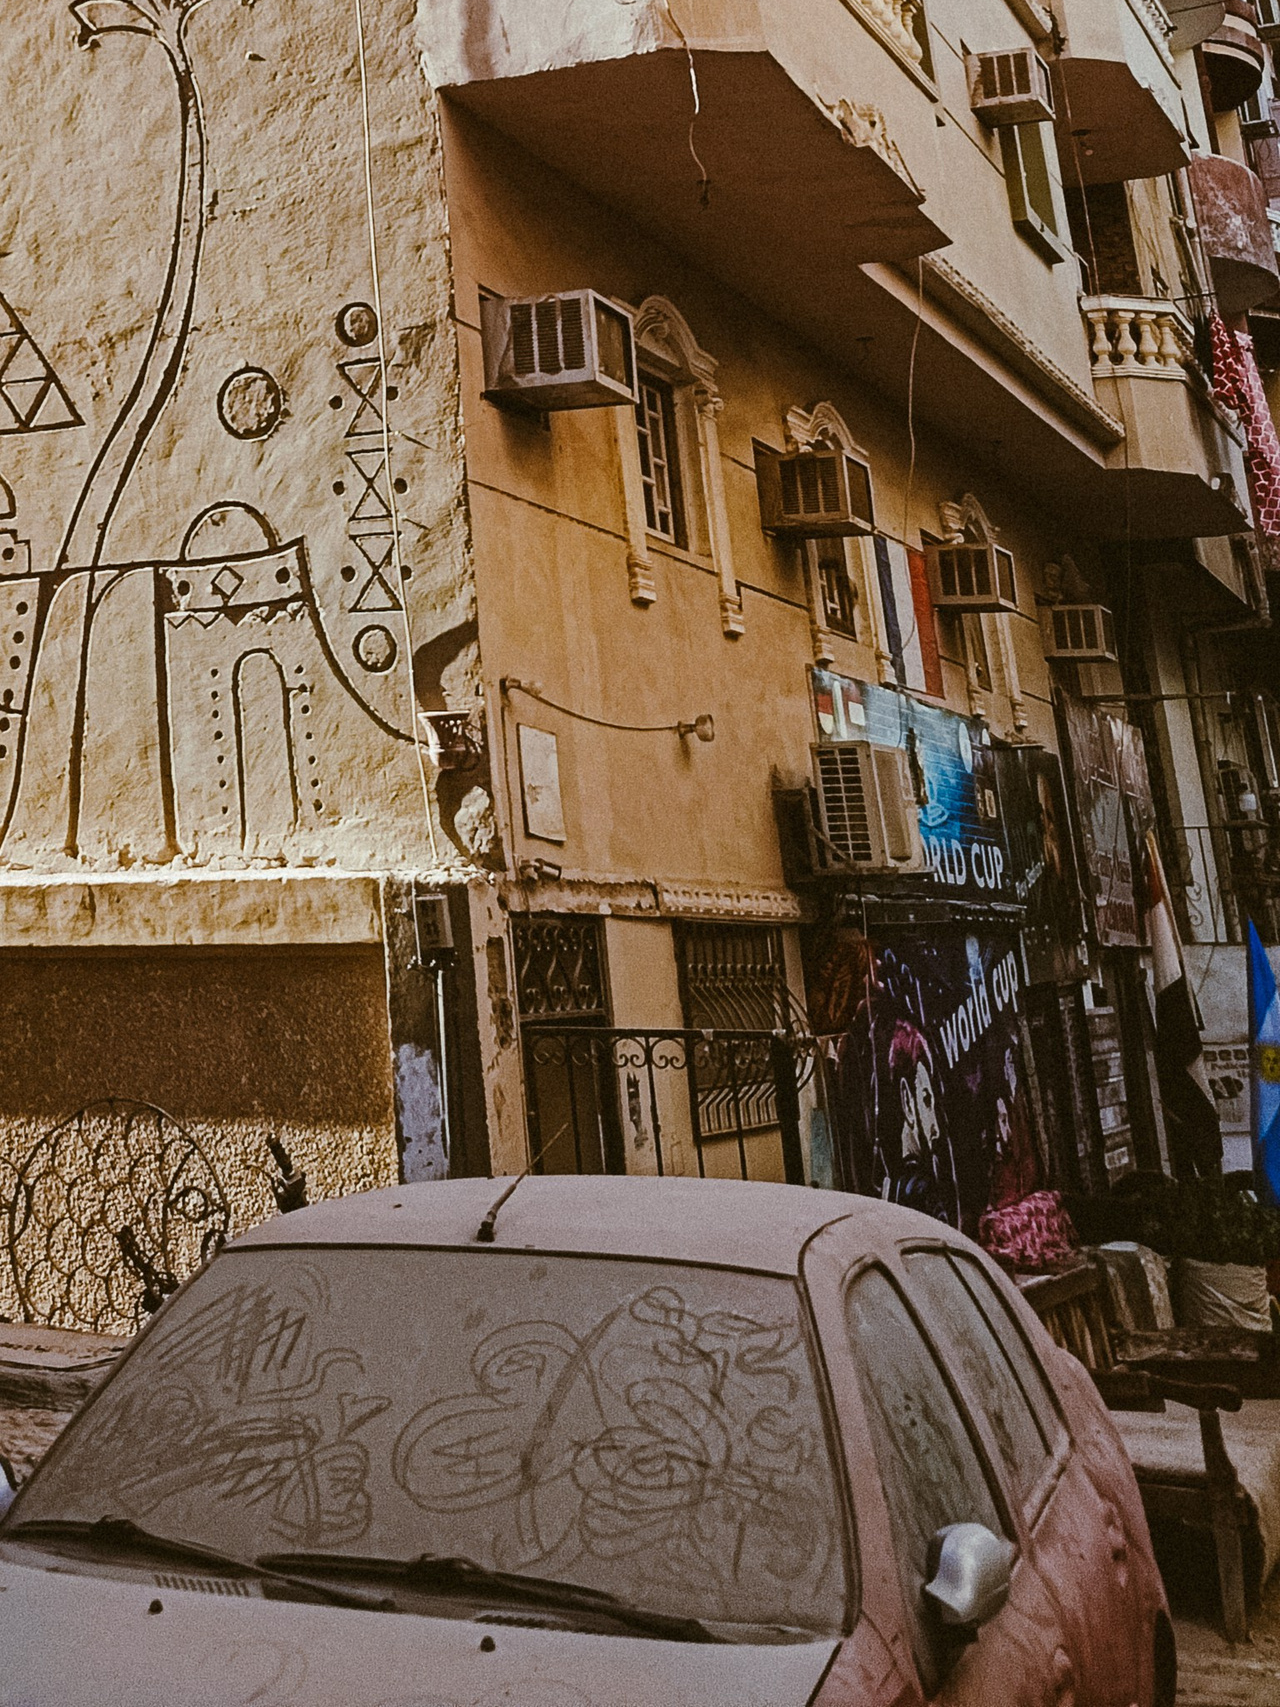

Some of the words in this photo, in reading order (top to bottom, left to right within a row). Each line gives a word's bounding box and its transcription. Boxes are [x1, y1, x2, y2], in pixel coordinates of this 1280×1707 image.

[920, 833, 967, 886] RLD
[971, 842, 1004, 890] CUP
[939, 957, 992, 1069] world
[993, 950, 1019, 1013] cup
